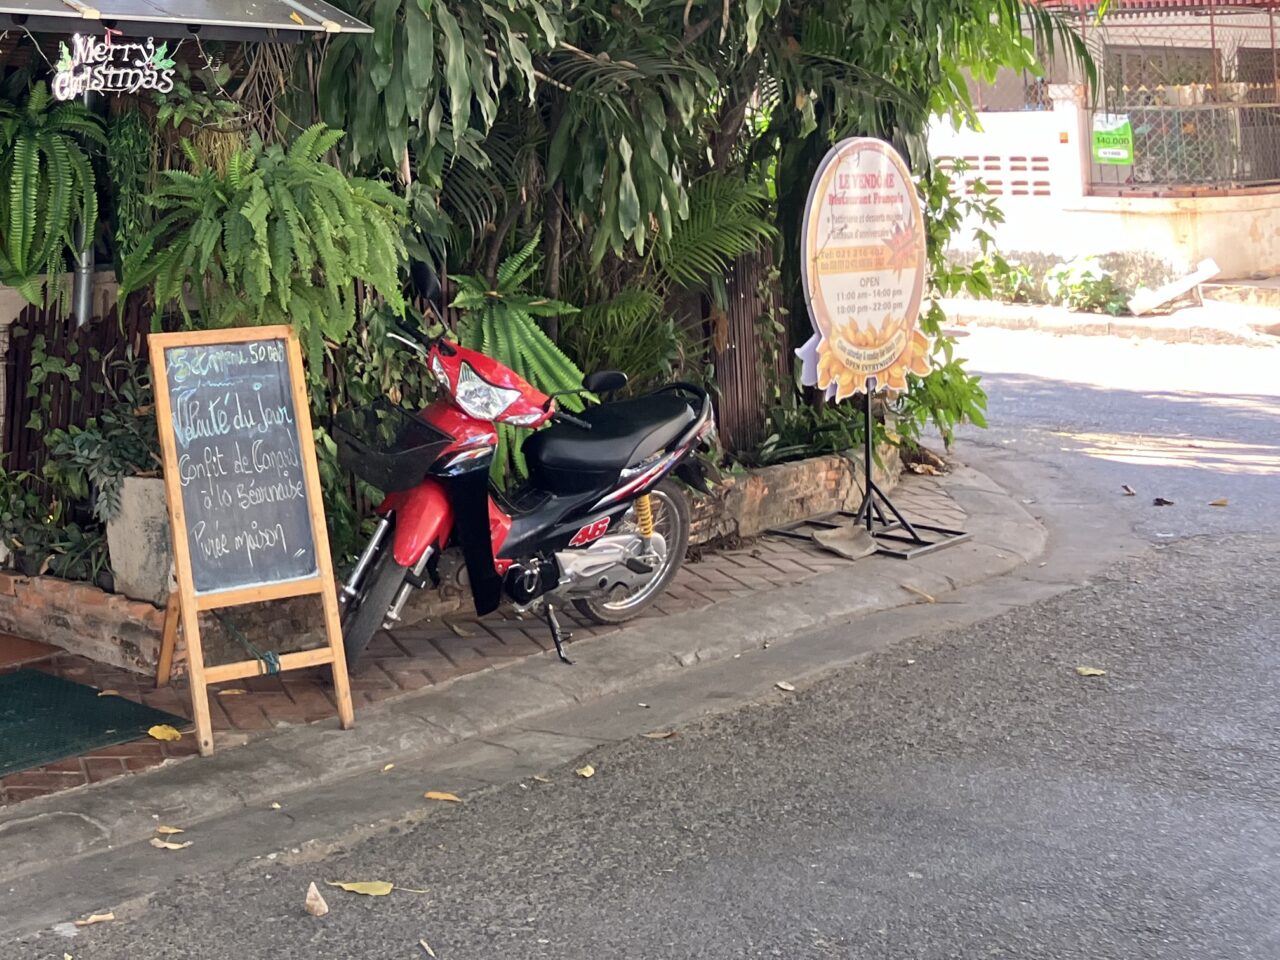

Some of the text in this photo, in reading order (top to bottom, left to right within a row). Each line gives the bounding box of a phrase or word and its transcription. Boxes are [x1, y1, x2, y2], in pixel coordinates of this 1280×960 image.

[72, 33, 154, 67] Merry
[851, 170, 895, 189] VENDÔE
[859, 276, 880, 288] OPEN
[836, 291, 856, 301] 11:00
[873, 301, 891, 311] 22:00
[233, 392, 256, 429] du
[179, 446, 227, 493] Confit
[234, 441, 253, 474] de
[568, 515, 610, 547] 46
